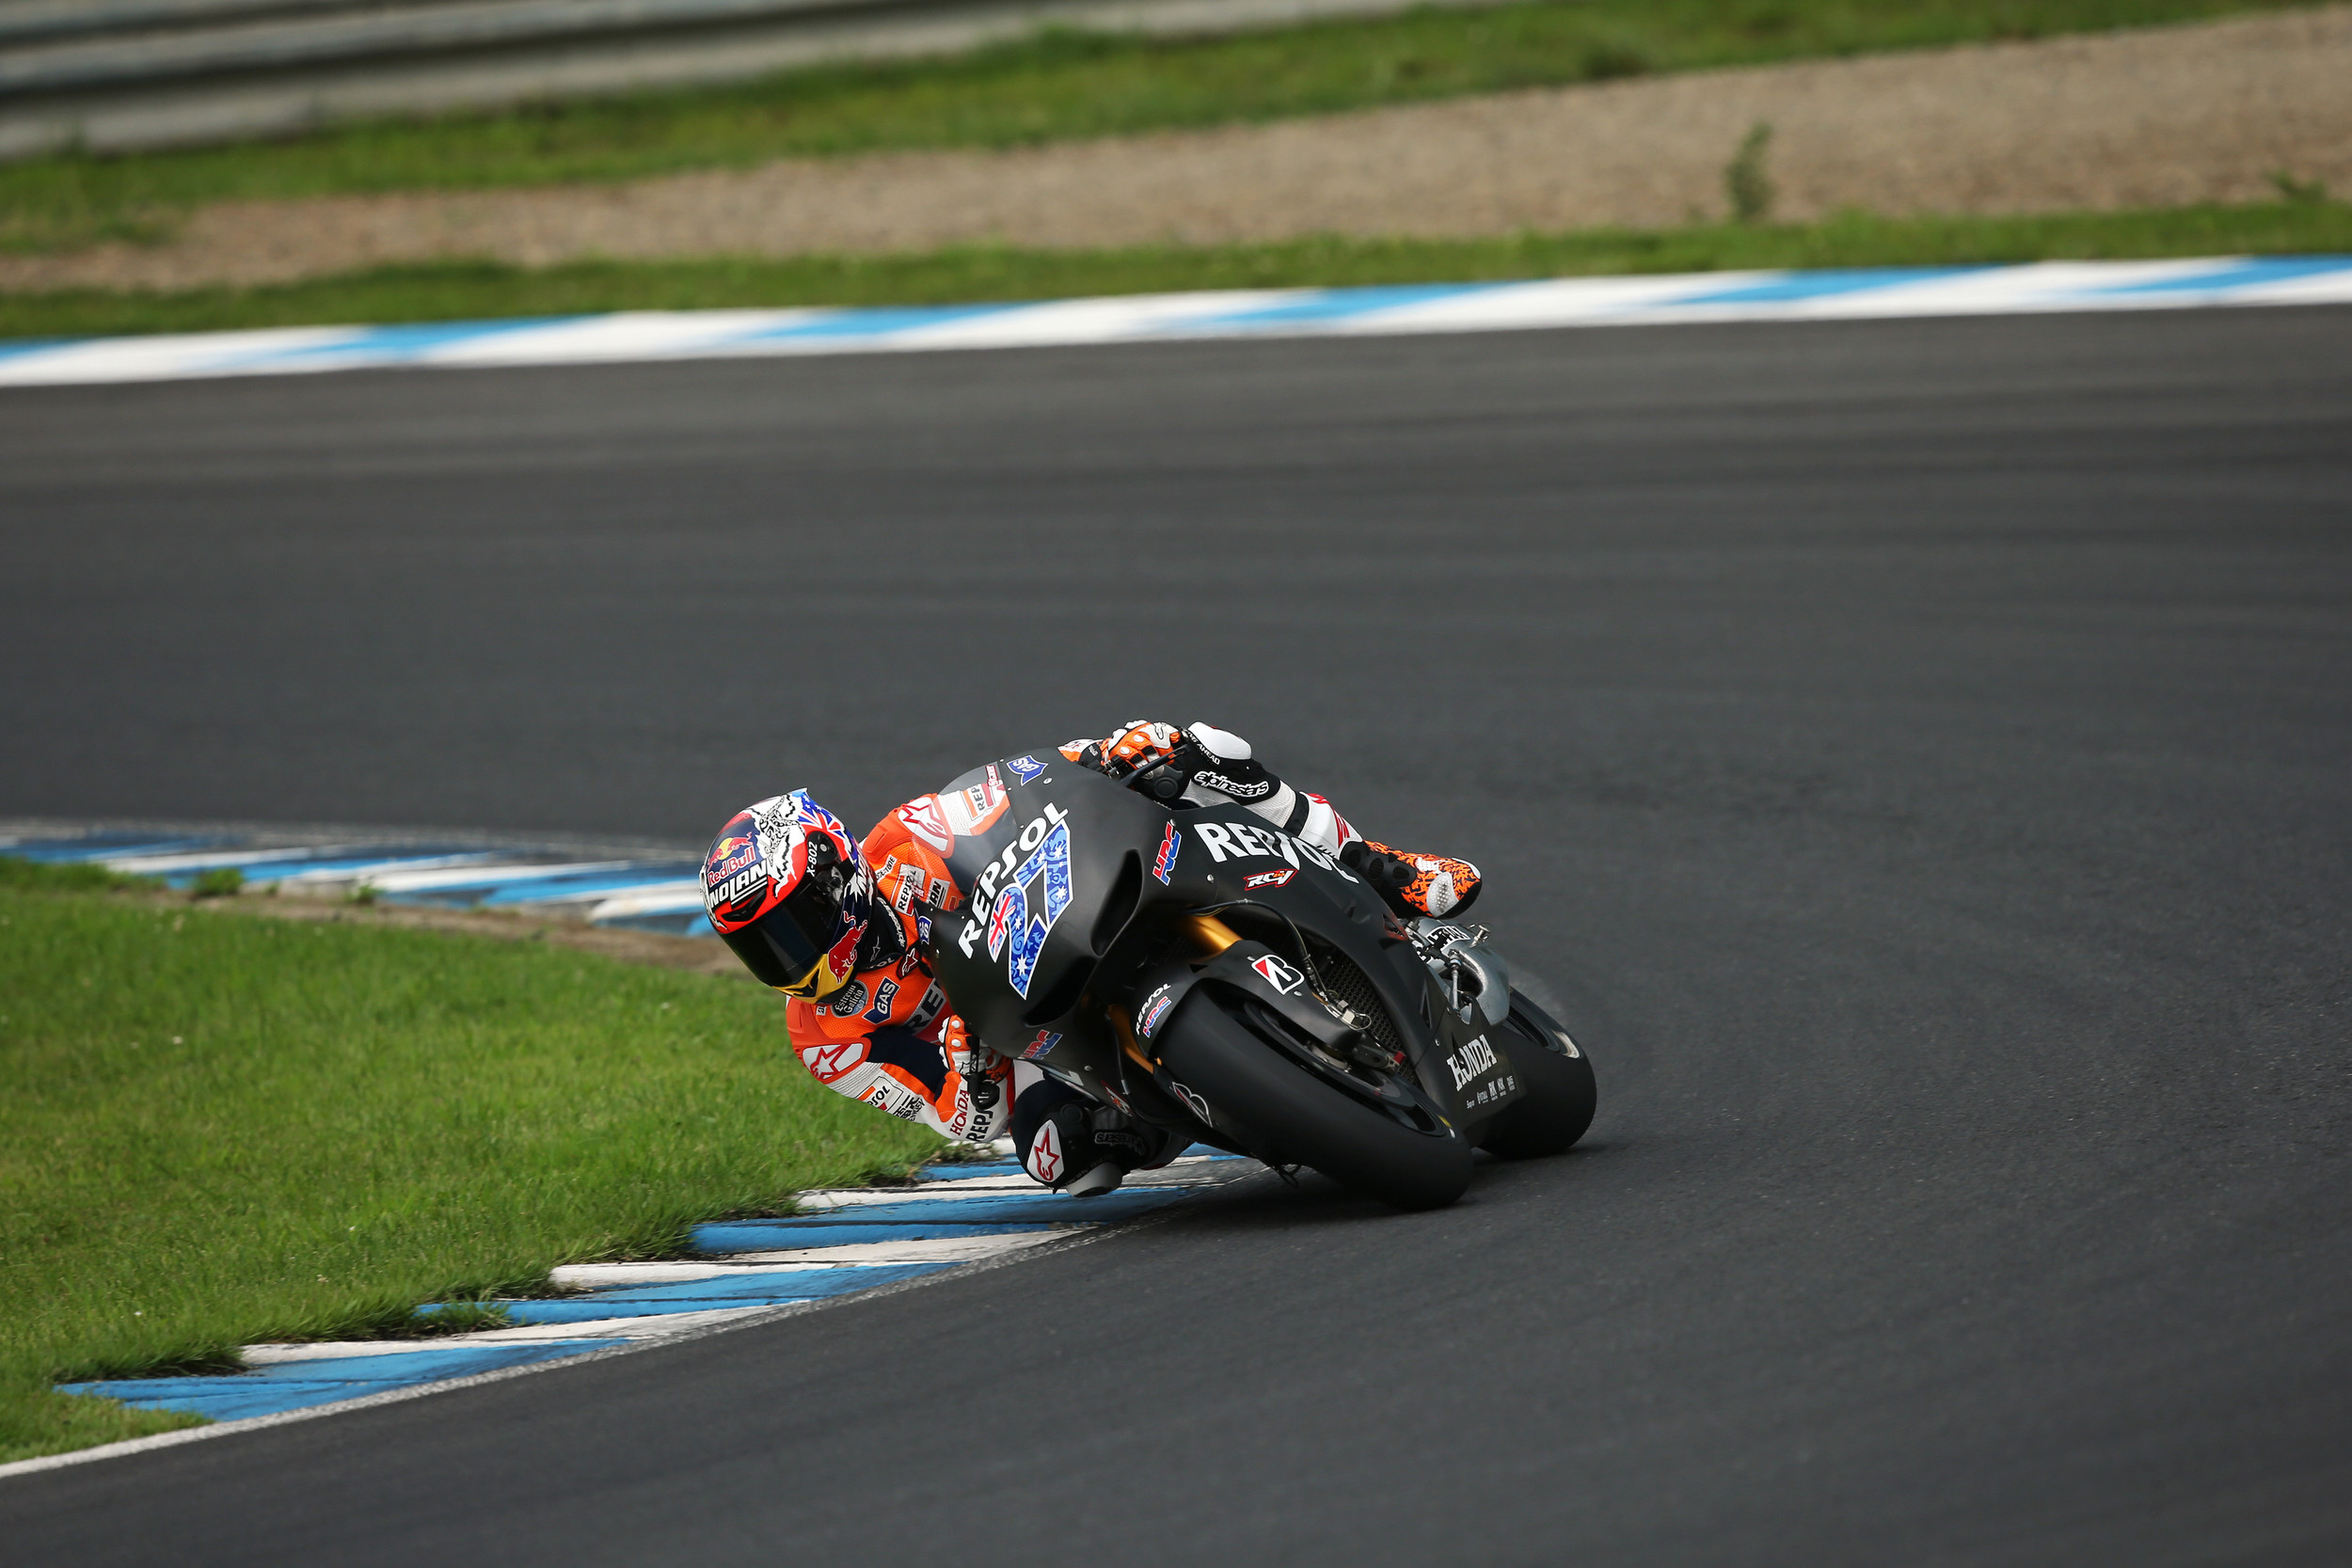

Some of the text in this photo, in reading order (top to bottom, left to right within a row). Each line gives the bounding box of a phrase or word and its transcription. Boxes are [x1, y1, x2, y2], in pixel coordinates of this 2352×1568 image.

[1197, 743, 1220, 765] AHEAD
[1194, 771, 1269, 798] alpinestars
[707, 846, 756, 887] Red Bull
[806, 842, 818, 877] X-802
[1152, 821, 1183, 886] HRC
[1193, 822, 1359, 884] REPSOL
[709, 859, 768, 909] NOLAN
[958, 802, 1069, 959] REPSOL
[988, 818, 1073, 1001] 27
[876, 981, 896, 1015] GAS
[1136, 984, 1171, 1035] REPSOL
[1143, 995, 1171, 1037] HRC
[1446, 1034, 1498, 1092] HONDA
[949, 1089, 971, 1136] HONDA
[965, 1107, 993, 1142] REPS
